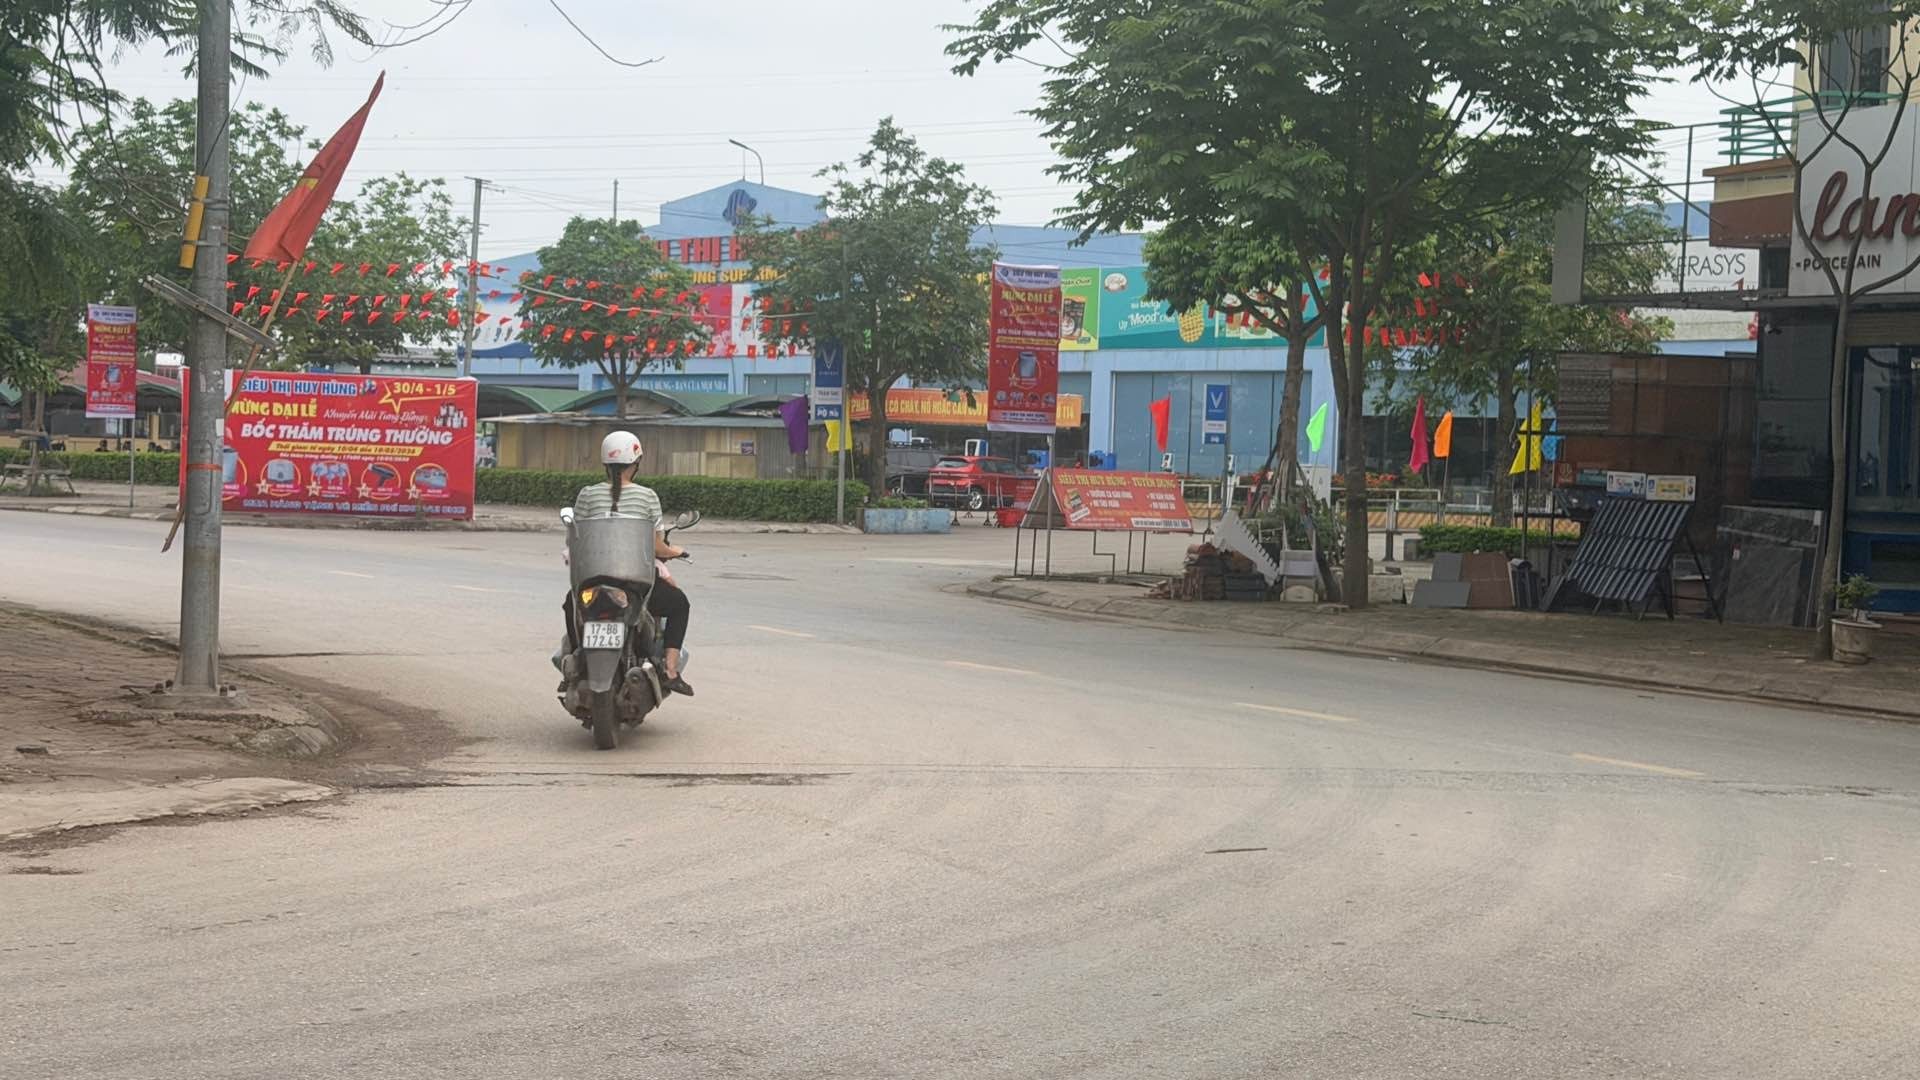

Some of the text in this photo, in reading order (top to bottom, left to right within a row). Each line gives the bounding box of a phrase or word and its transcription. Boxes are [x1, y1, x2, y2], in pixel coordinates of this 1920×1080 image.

[271, 379, 291, 397] THỊ
[293, 379, 319, 395] HUY
[320, 379, 357, 396] HÙNG
[393, 381, 424, 395] 30/4
[434, 384, 456, 396] 1/5
[241, 418, 454, 446] BỐC THĂM TRÚNG THƯỞNG
[587, 635, 621, 647] 172.45
